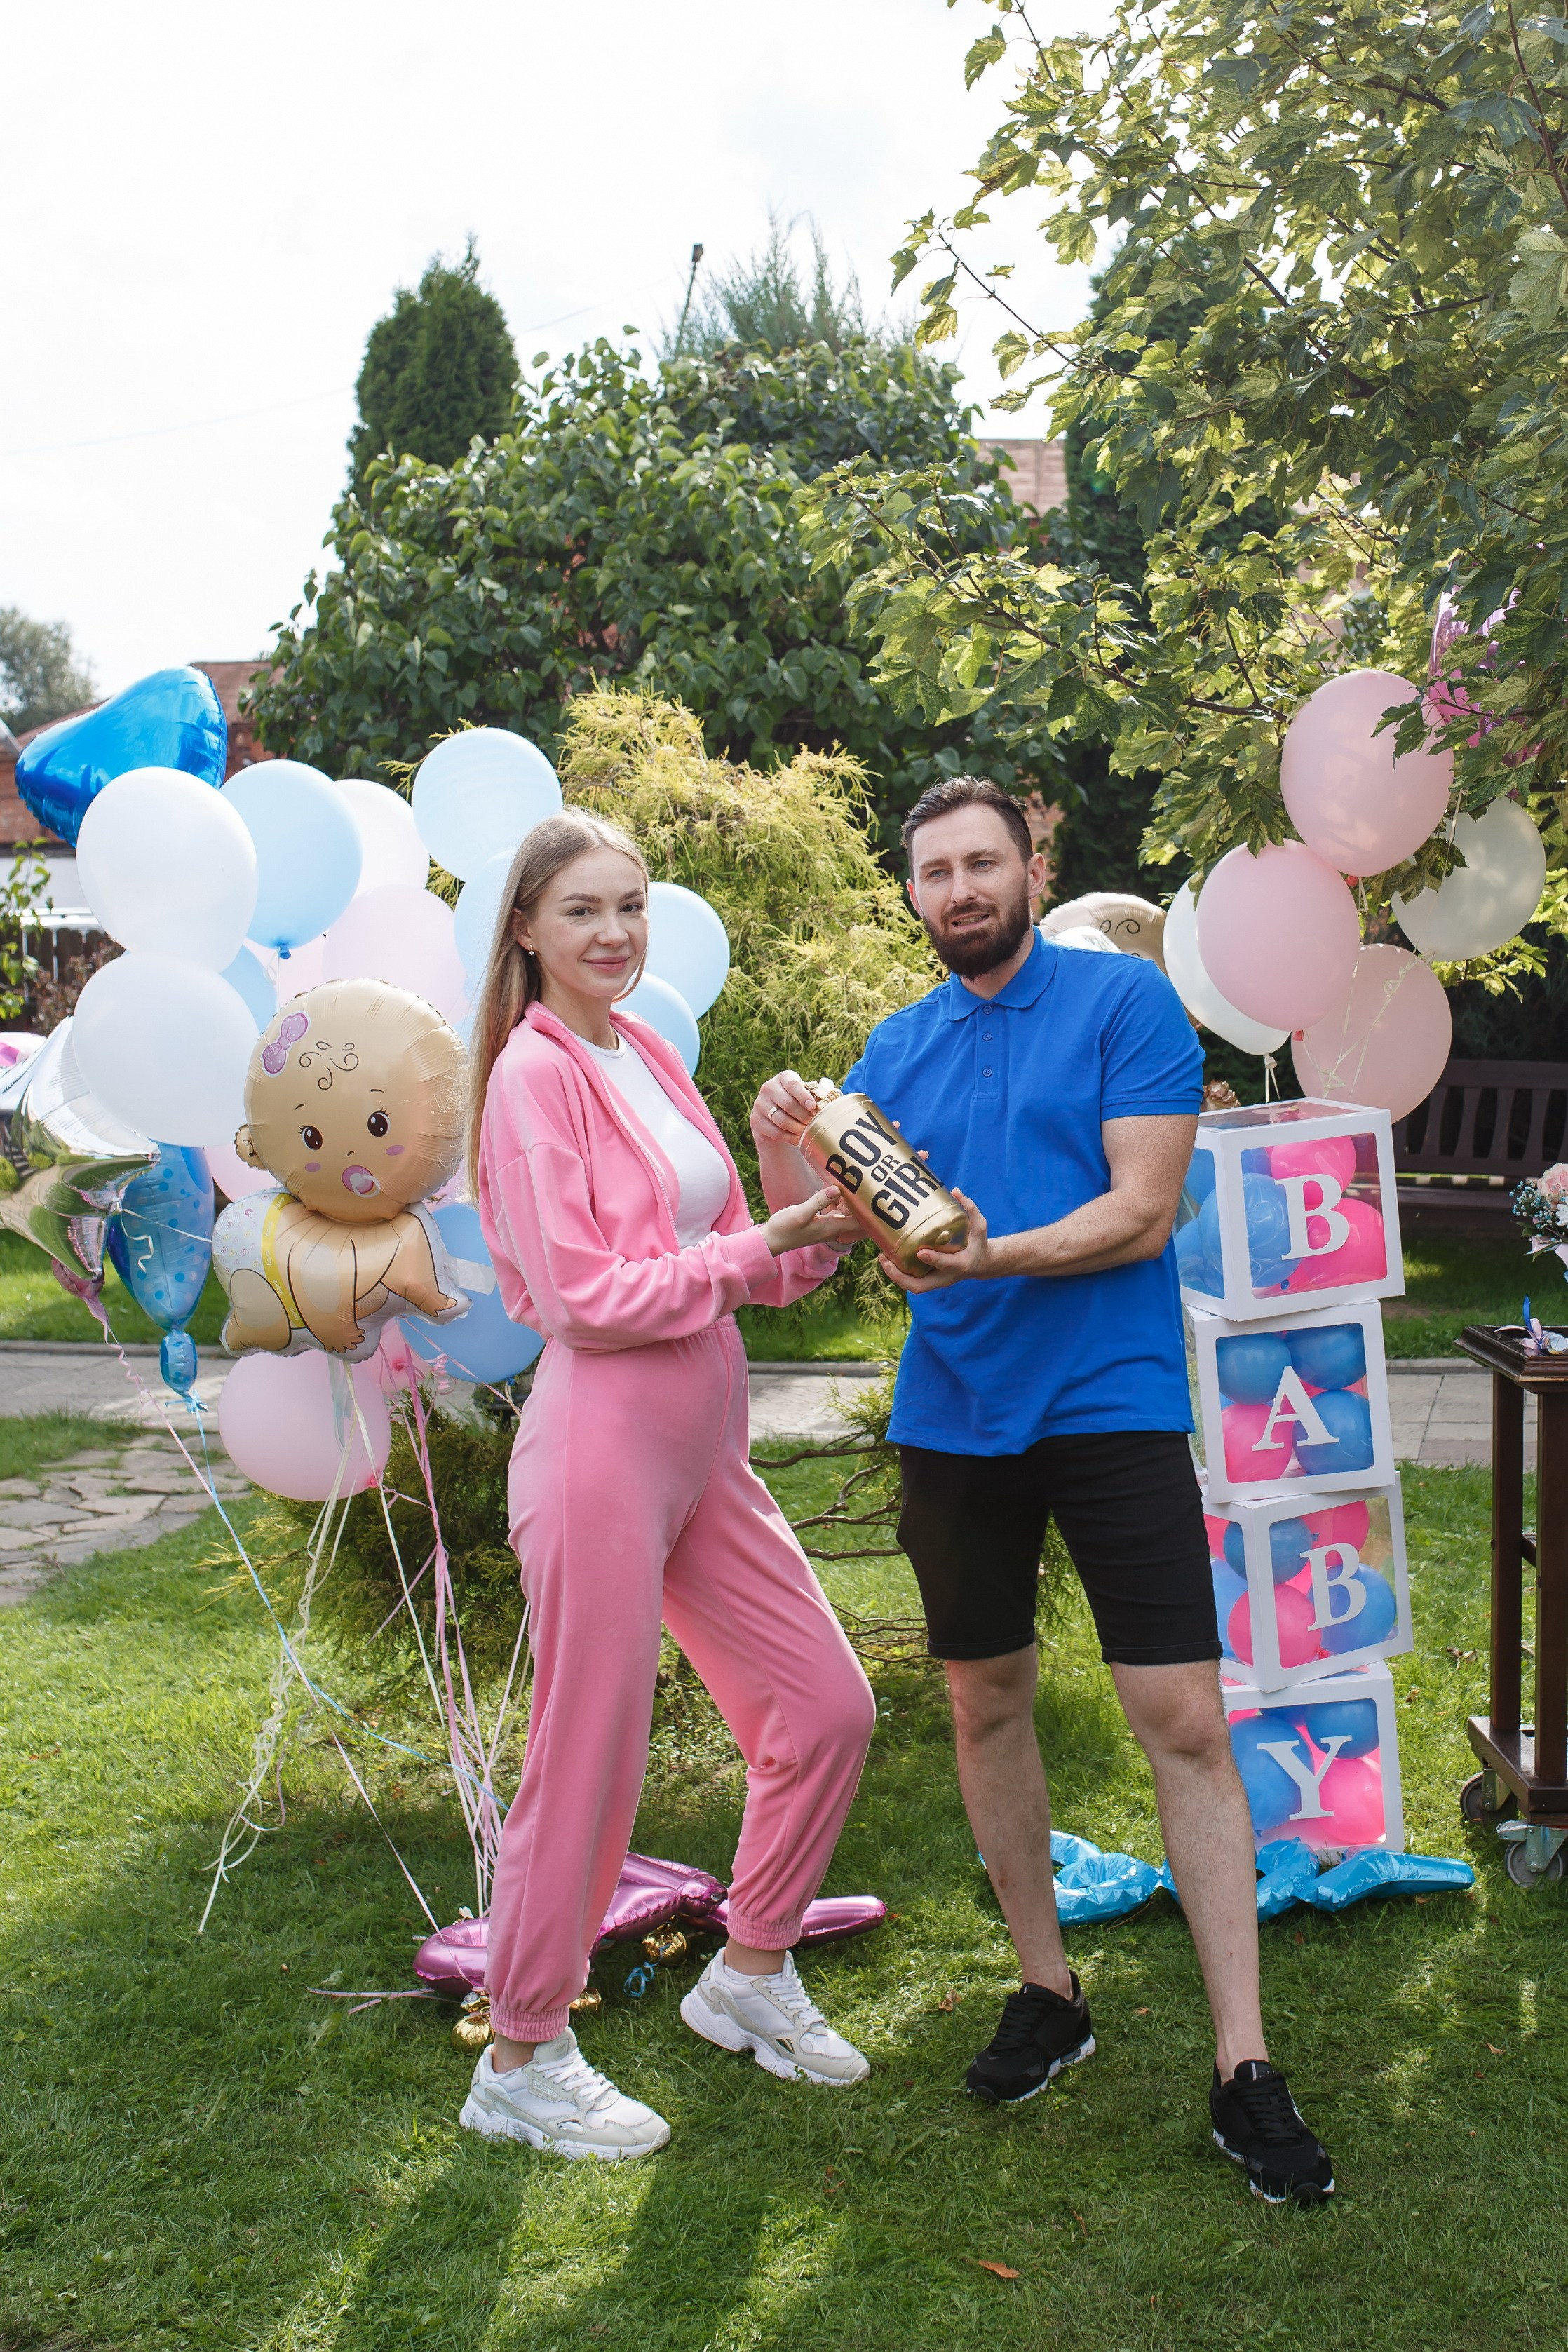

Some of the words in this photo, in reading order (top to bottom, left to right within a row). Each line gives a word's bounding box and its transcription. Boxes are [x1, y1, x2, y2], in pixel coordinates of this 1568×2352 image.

[825, 1110, 898, 1194] BOY
[870, 1154, 900, 1182] OR
[1275, 1173, 1349, 1260] B
[1252, 1365, 1339, 1452] A
[1299, 1542, 1367, 1632] B
[1256, 1735, 1352, 1820] Y
